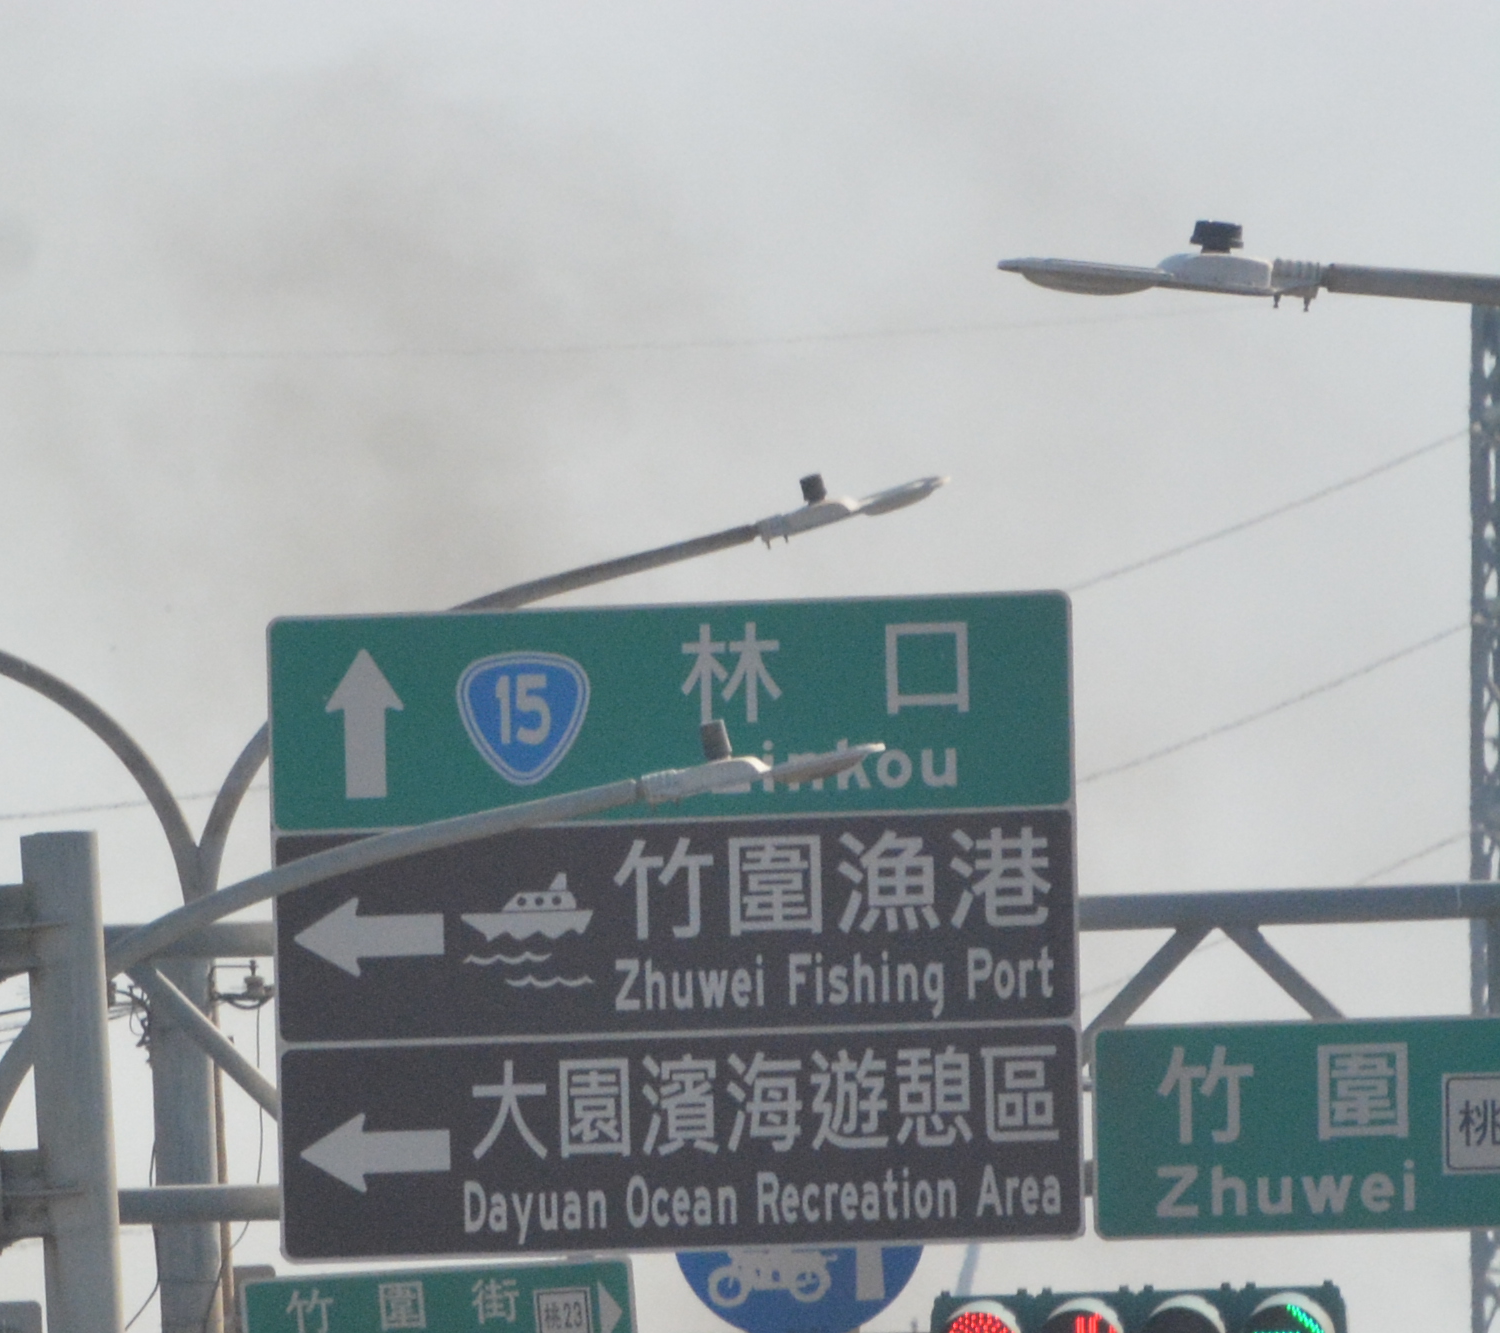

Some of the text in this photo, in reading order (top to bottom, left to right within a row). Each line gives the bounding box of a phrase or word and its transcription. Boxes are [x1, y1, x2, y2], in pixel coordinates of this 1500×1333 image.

[494, 673, 553, 747] 15
[680, 620, 972, 724] 林口
[711, 738, 957, 795] ikou
[612, 826, 1053, 940] 竹圍漁港
[615, 948, 1055, 1019] Zhuwei Fishing Port
[471, 1044, 1060, 1160] 大園濱海遊憩區
[1157, 1042, 1410, 1145] 竹圍
[463, 1163, 1062, 1244] Dayuan Ocean Recreation Area
[1156, 1160, 1417, 1219] Zhuwei
[544, 1301, 584, 1330] 桃23
